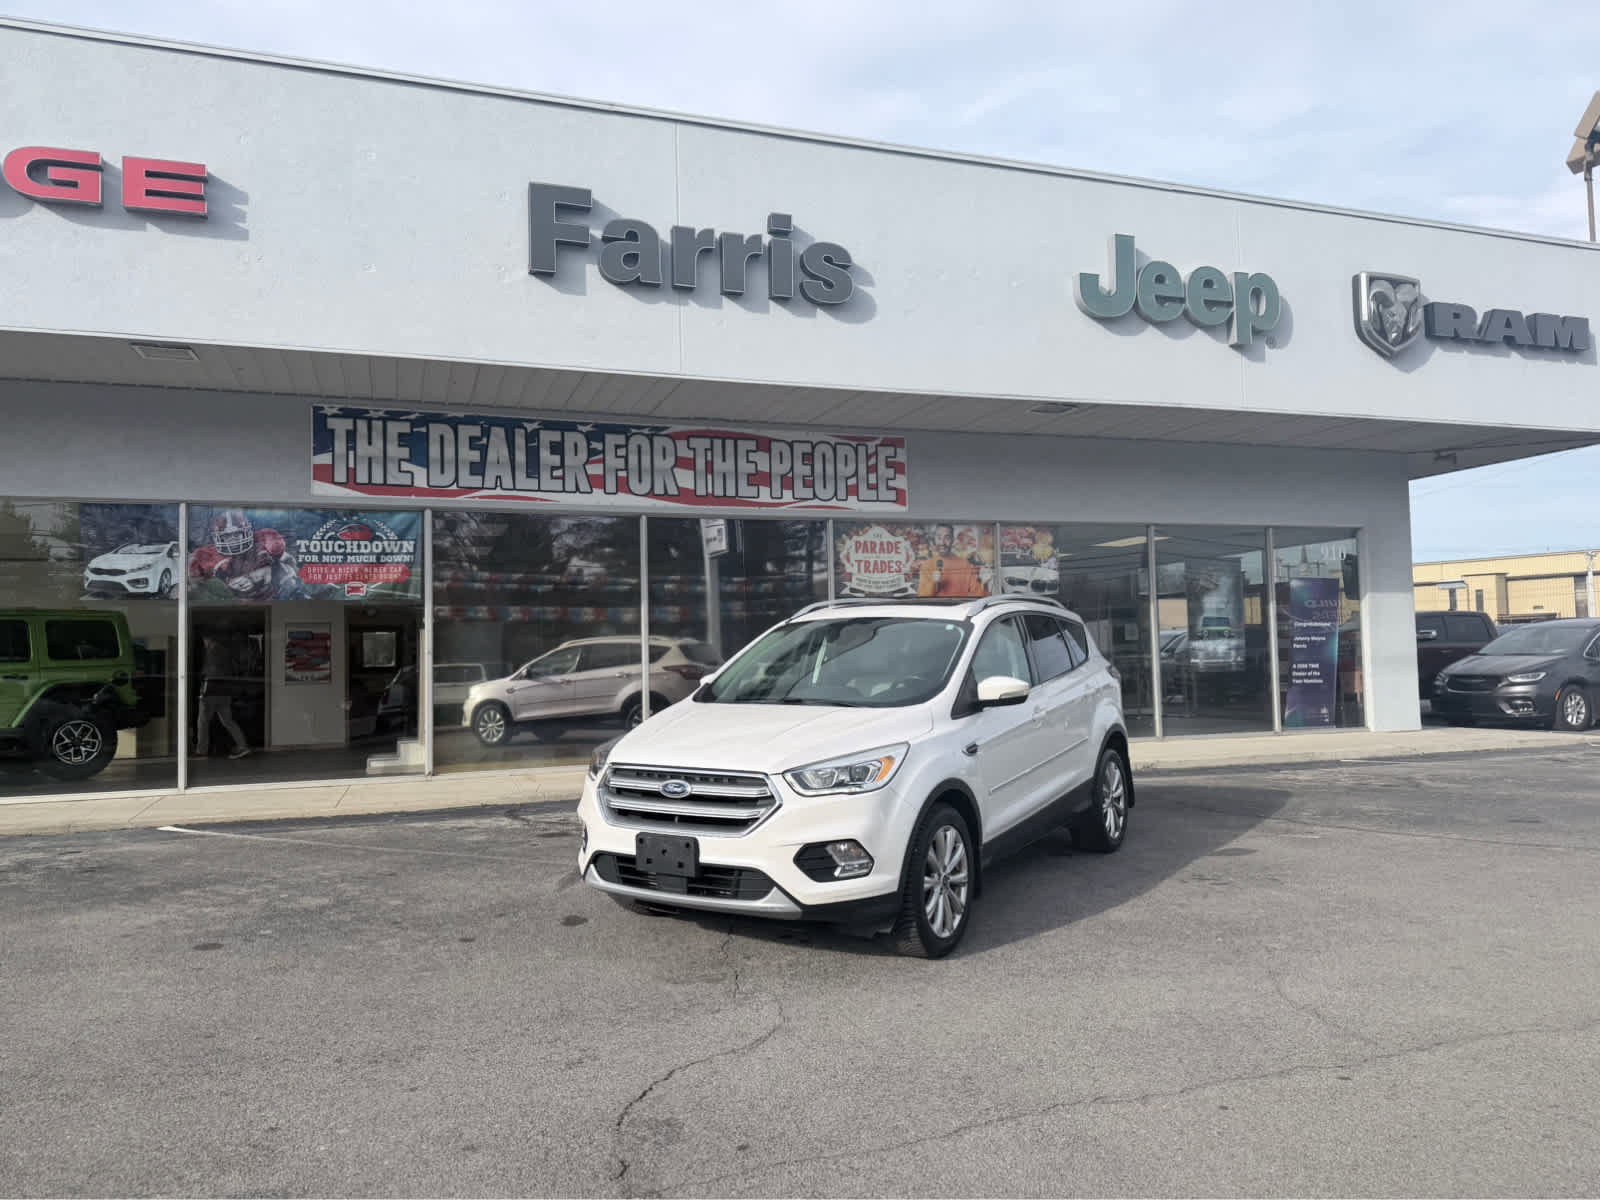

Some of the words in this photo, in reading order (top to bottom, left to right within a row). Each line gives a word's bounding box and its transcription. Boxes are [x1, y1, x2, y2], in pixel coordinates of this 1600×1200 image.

[528, 181, 854, 305] Farris
[1075, 233, 1281, 347] Jeep
[1424, 301, 1590, 351] RAM
[326, 417, 414, 486] THE
[426, 422, 593, 494] DEALER
[603, 432, 681, 497] FOR
[687, 436, 760, 499] THE
[769, 439, 898, 502] PEOPLE
[296, 540, 415, 553] TOUCHDOWN
[298, 554, 319, 563] FOR
[322, 554, 344, 563] NOT
[347, 554, 377, 563] MUCH
[380, 554, 414, 563] DOWN!
[855, 540, 902, 554] PARADE
[855, 559, 902, 574] TRADES
